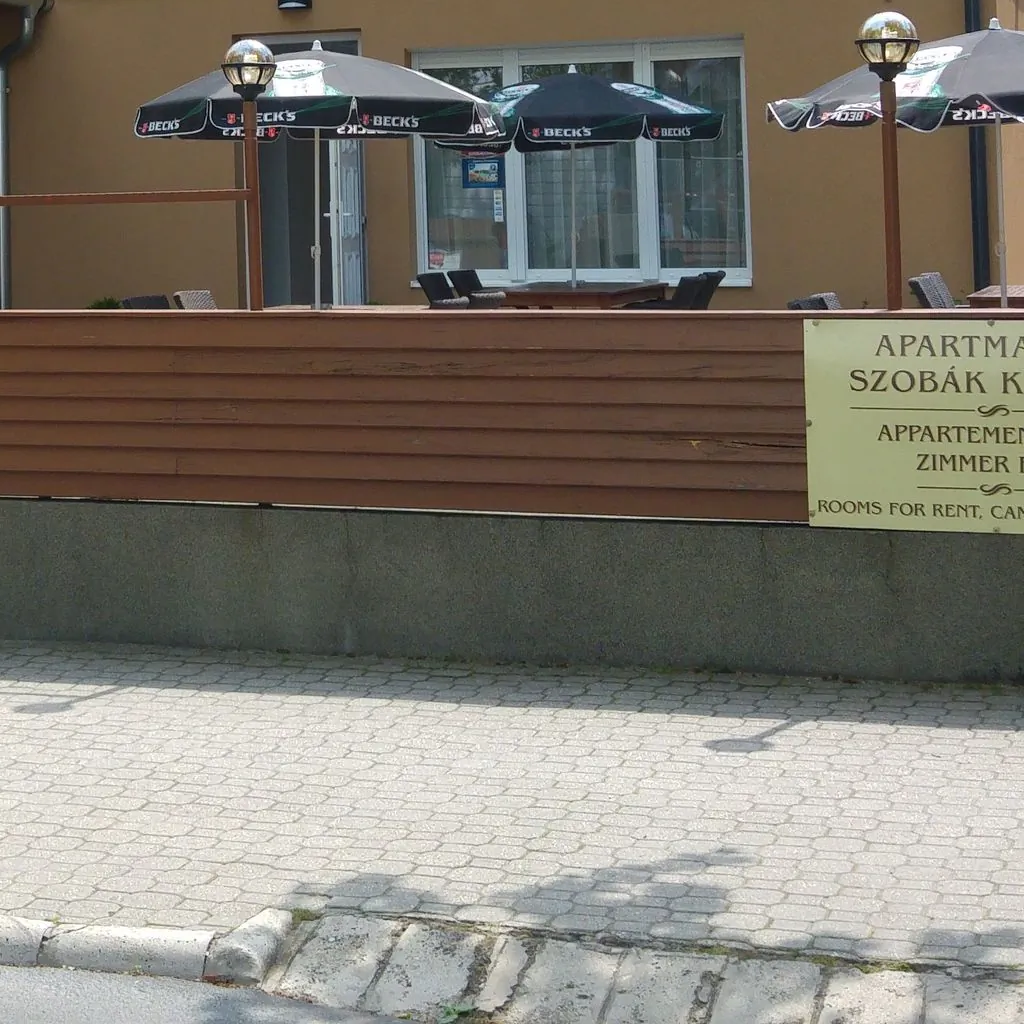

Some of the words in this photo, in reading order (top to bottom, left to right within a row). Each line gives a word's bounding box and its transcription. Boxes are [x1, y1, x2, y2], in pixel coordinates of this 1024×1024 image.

[373, 114, 419, 128] BECK'S
[544, 126, 592, 137] BECK'S
[874, 334, 1024, 358] APARTMA
[849, 365, 987, 394] SZOBÁK
[1001, 371, 1024, 394] K
[916, 453, 1010, 474] ZIMMER
[817, 499, 882, 515] ROOMS
[889, 502, 926, 517] FOR
[932, 504, 983, 520] RENT,
